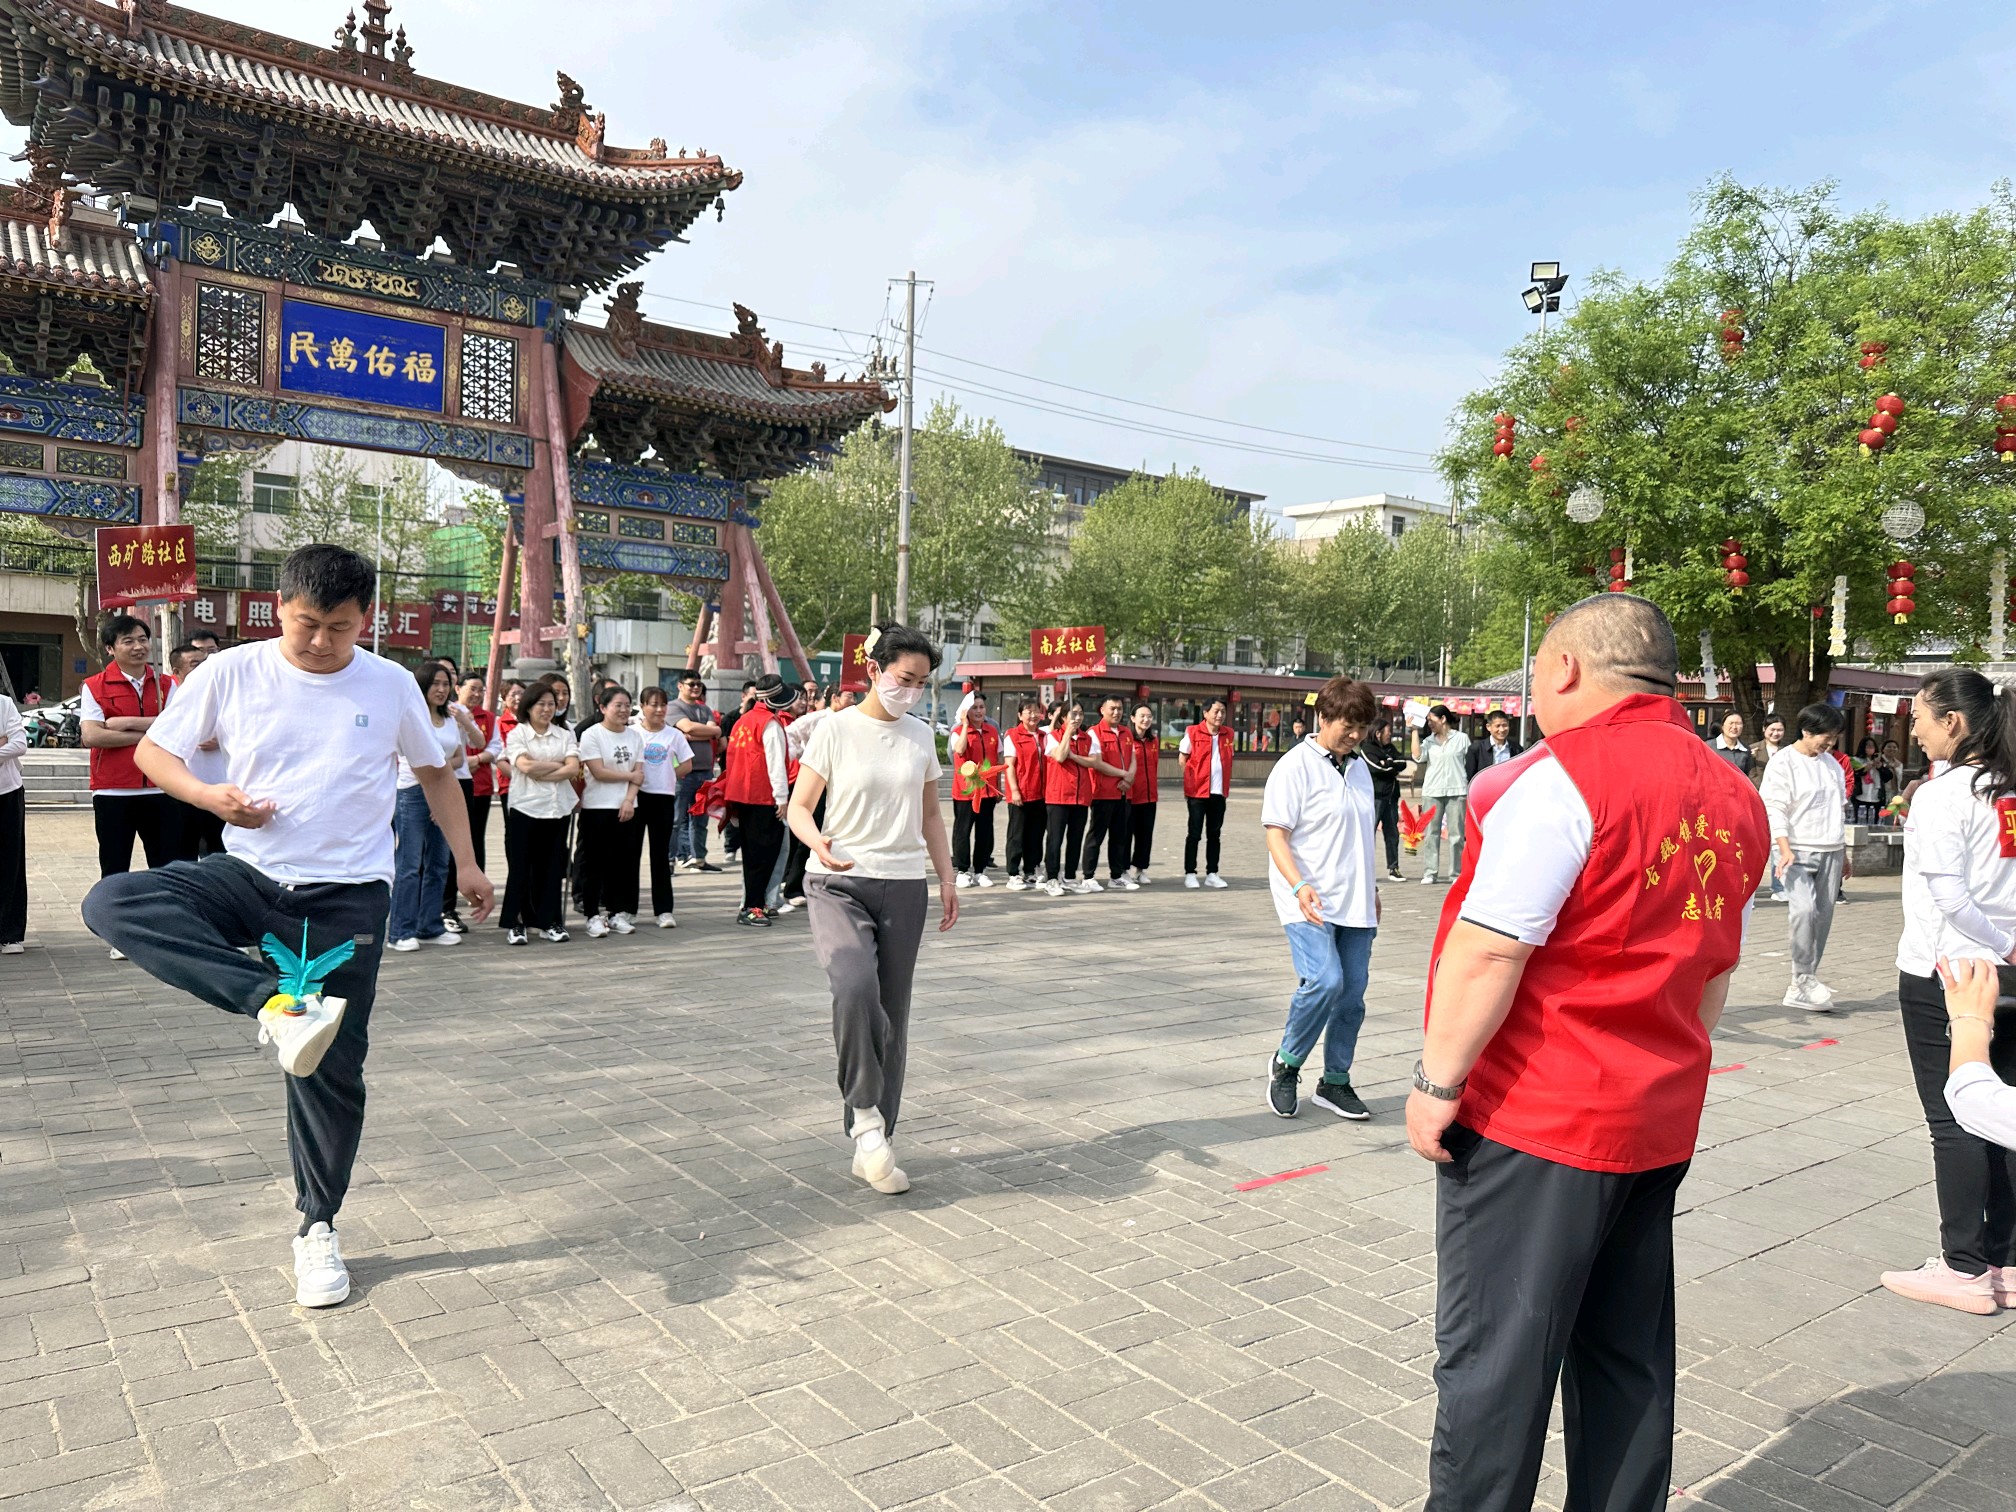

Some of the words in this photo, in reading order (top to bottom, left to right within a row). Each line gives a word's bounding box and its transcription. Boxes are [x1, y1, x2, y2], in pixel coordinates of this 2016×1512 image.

[107, 537, 187, 570] 西矿路社区
[1040, 634, 1097, 656] 南关社区
